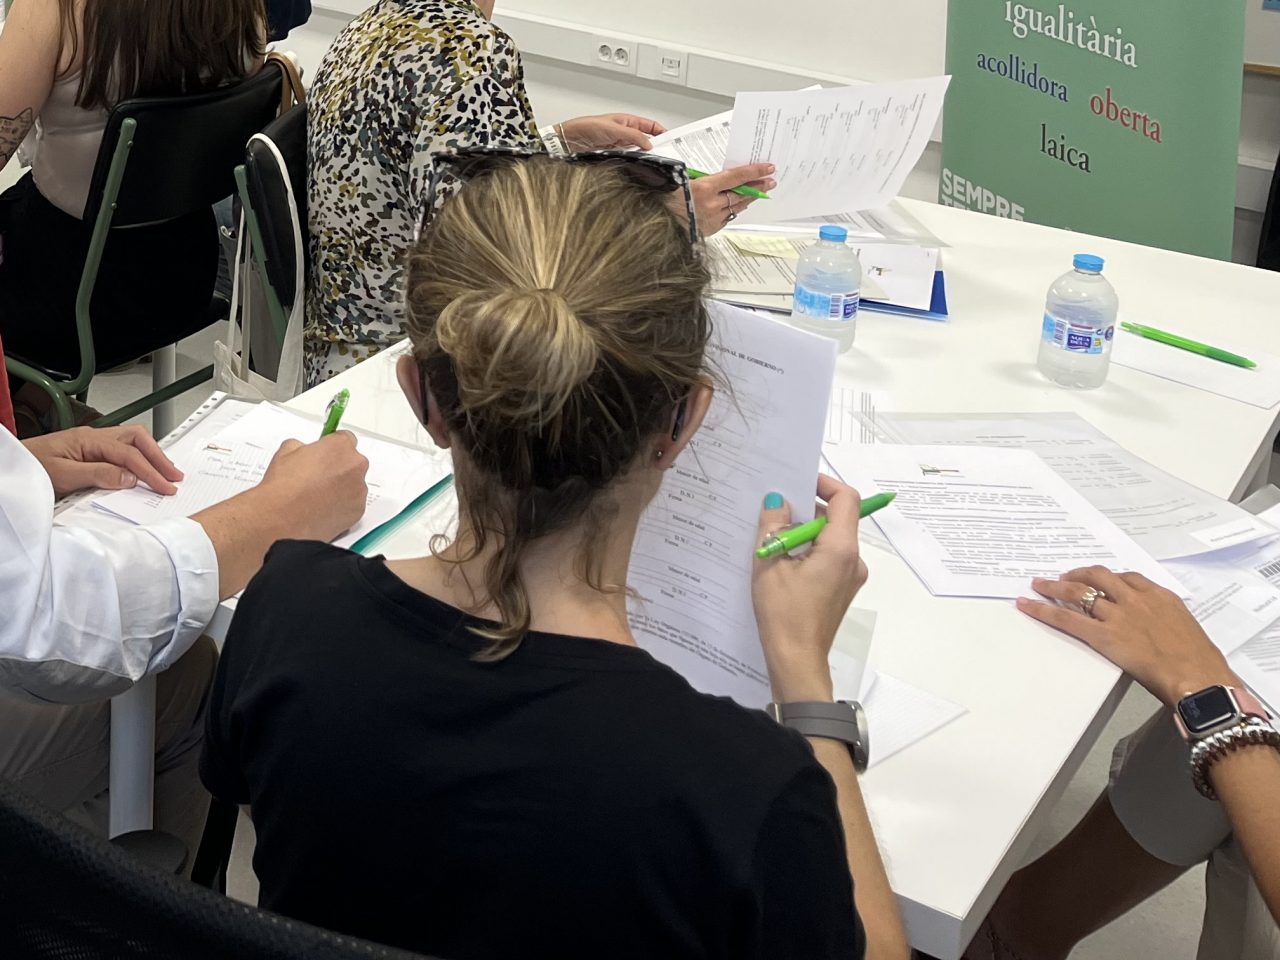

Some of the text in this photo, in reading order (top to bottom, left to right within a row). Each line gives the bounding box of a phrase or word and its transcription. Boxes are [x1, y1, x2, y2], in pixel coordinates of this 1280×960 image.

[976, 52, 1069, 104] acollidora
[1089, 87, 1163, 145] oberta
[1040, 123, 1092, 173] laica
[941, 167, 1025, 222] SEMPRE
